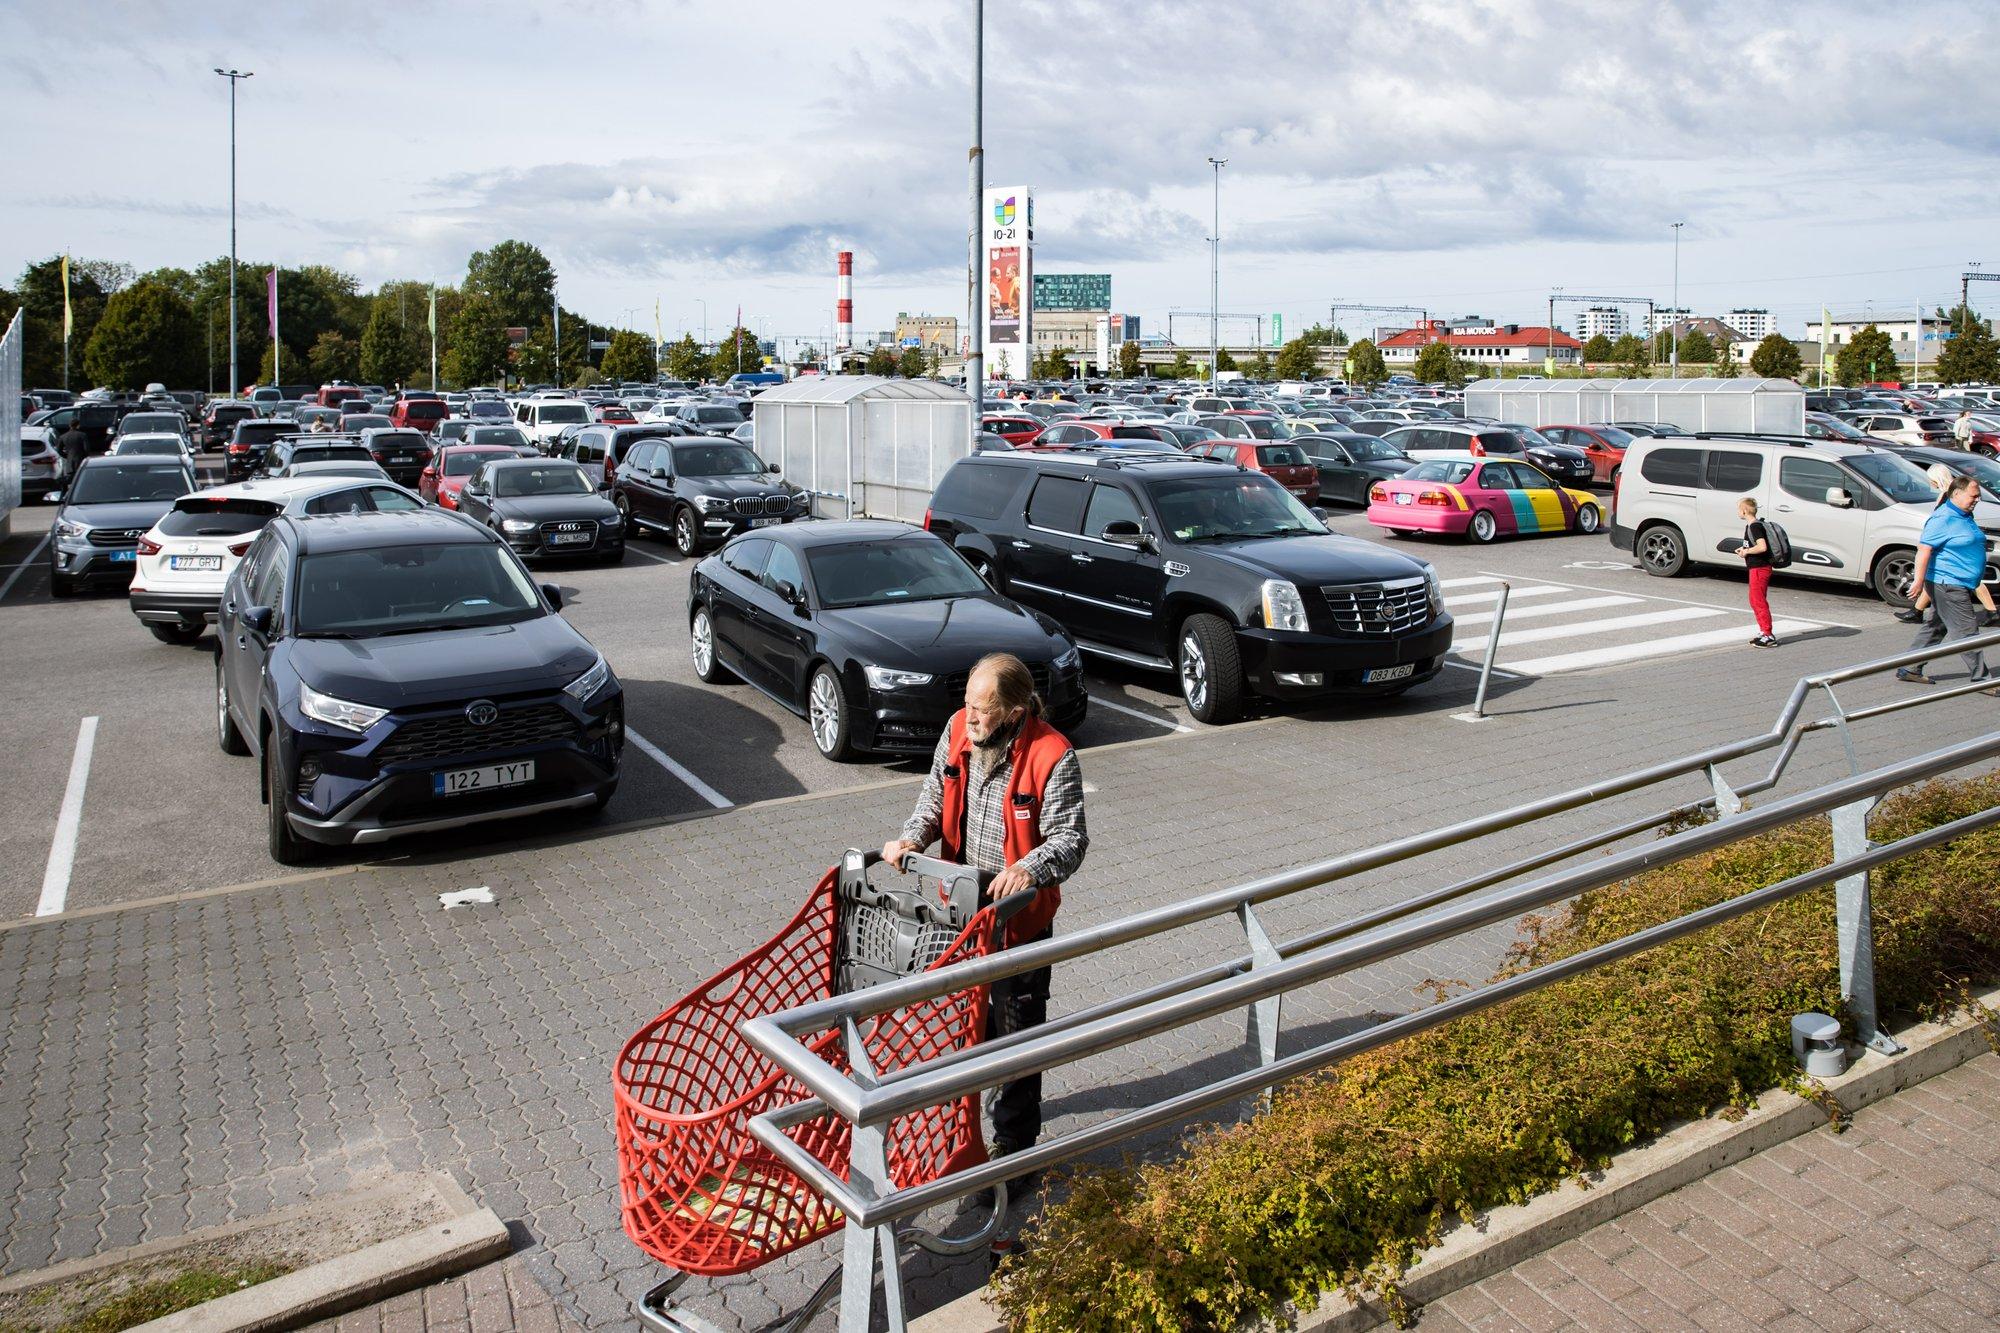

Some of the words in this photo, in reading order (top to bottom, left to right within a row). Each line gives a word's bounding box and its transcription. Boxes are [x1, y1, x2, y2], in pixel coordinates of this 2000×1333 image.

[994, 229, 1016, 240] 10-21
[1453, 328, 1465, 336] KIA
[1466, 326, 1496, 335] MOTORS
[178, 555, 194, 567] 777
[199, 555, 218, 567] GRY
[1370, 669, 1388, 681] 083
[1390, 665, 1412, 678] KBD
[449, 770, 480, 790] 122
[494, 763, 530, 783] TYT
